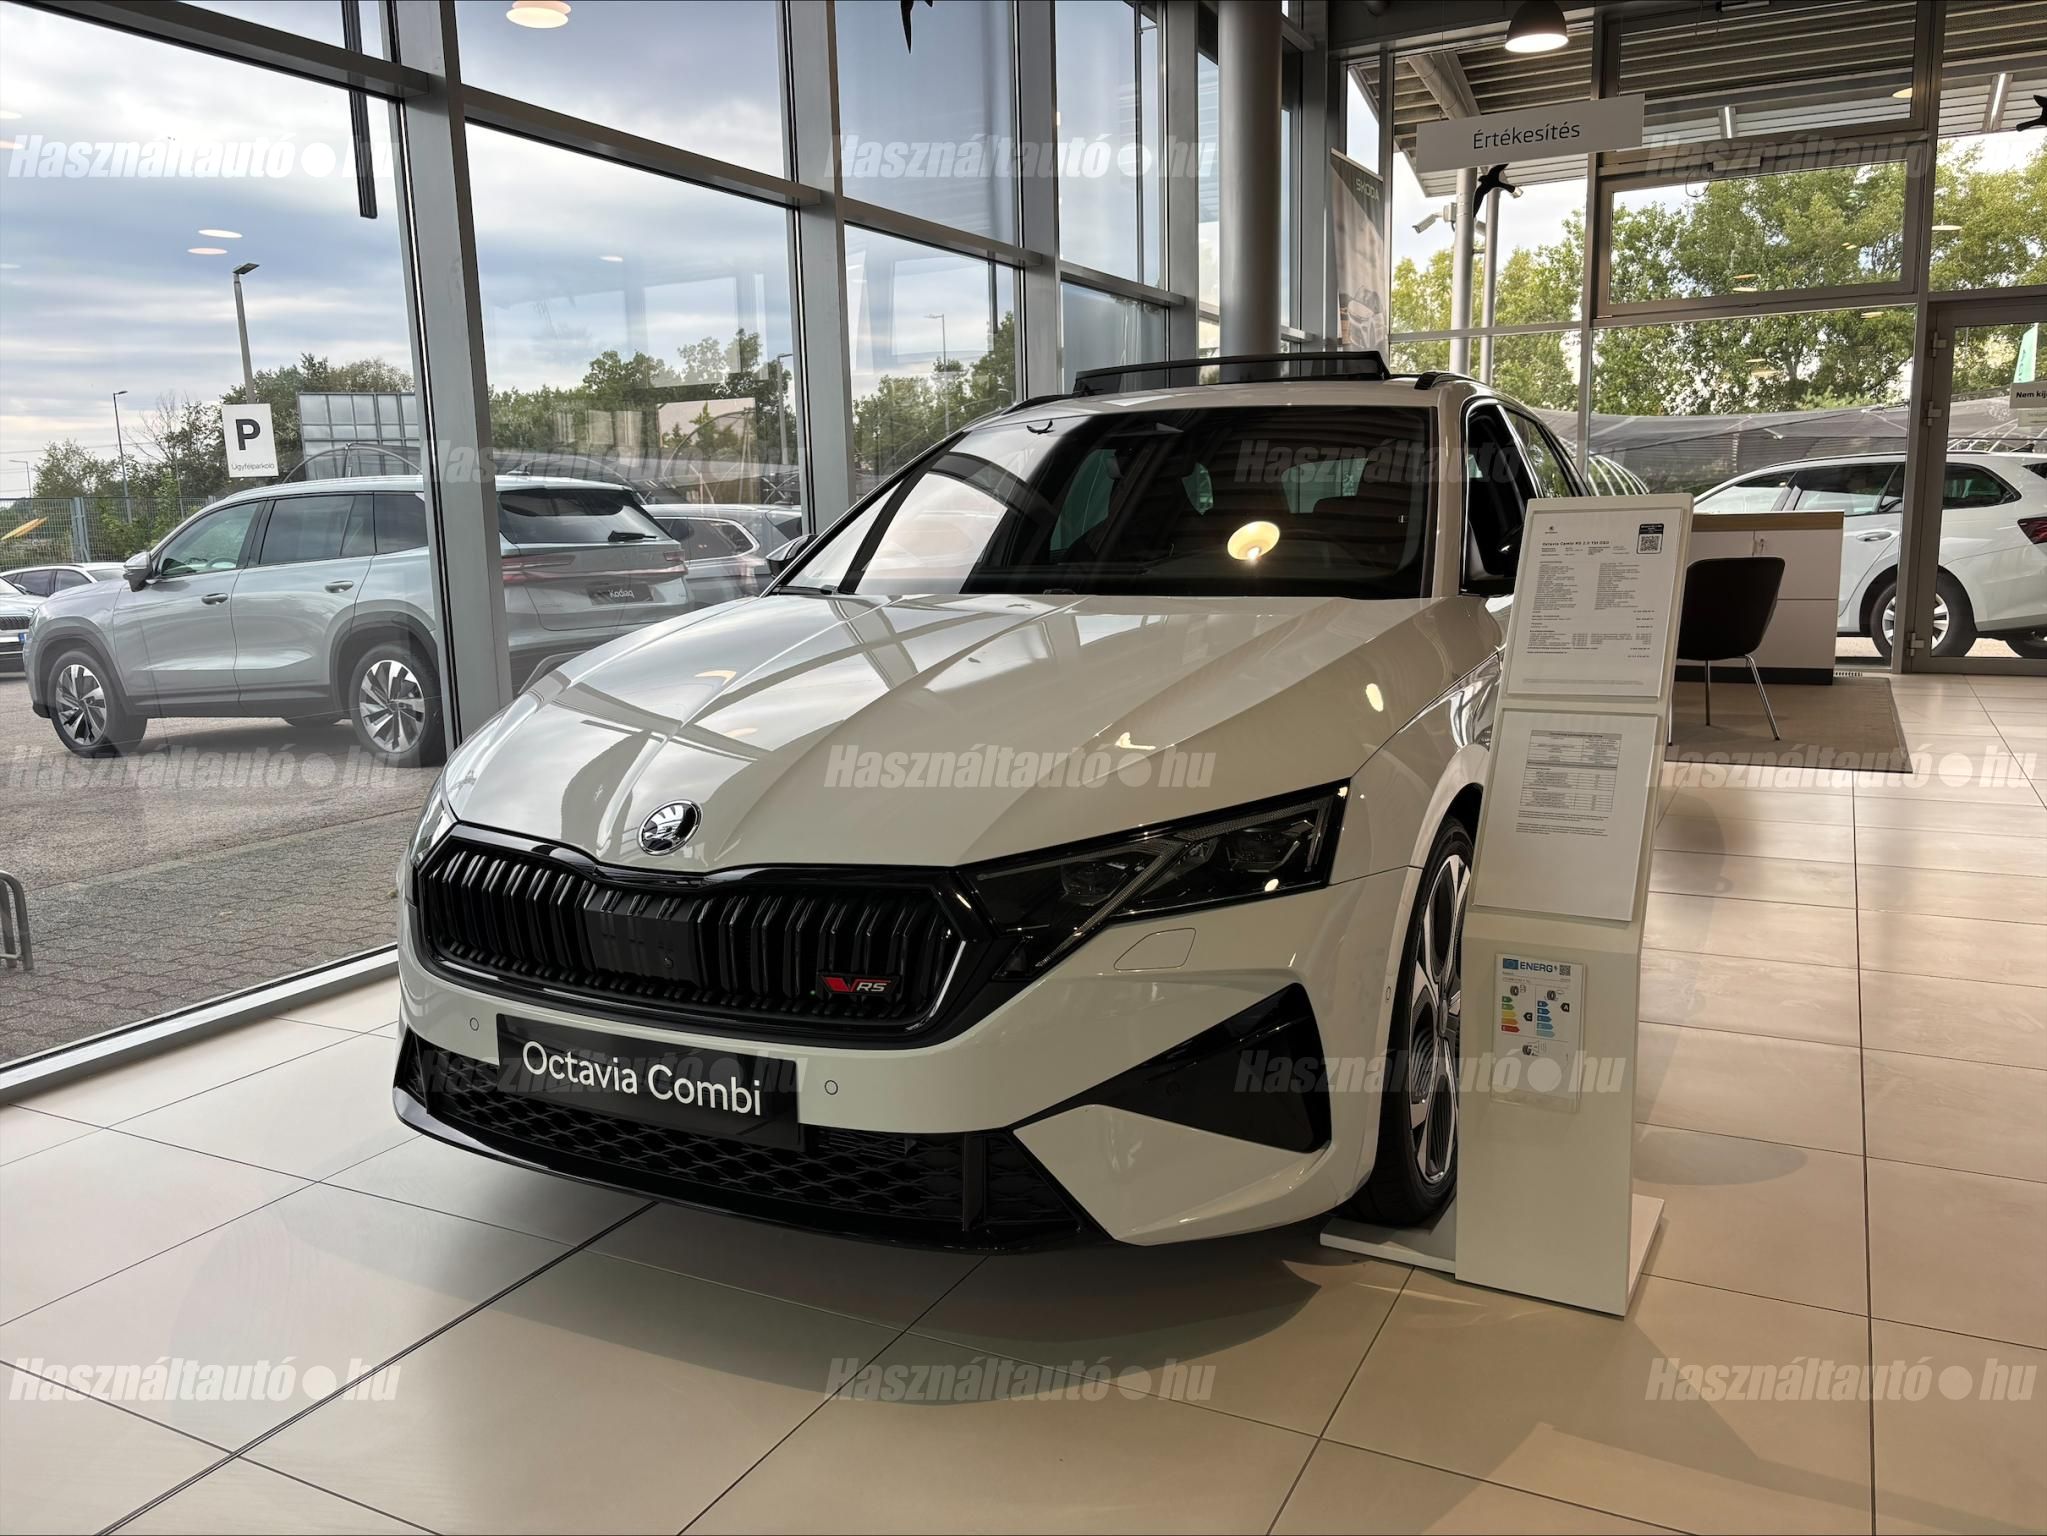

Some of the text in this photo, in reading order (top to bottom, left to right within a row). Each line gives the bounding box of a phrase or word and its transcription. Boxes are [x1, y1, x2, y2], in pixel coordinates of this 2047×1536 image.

[1473, 121, 1581, 150] Értékesítés
[235, 418, 261, 451] P
[1520, 961, 1554, 973] ENERG
[522, 1040, 762, 1116] Octavia Combi
